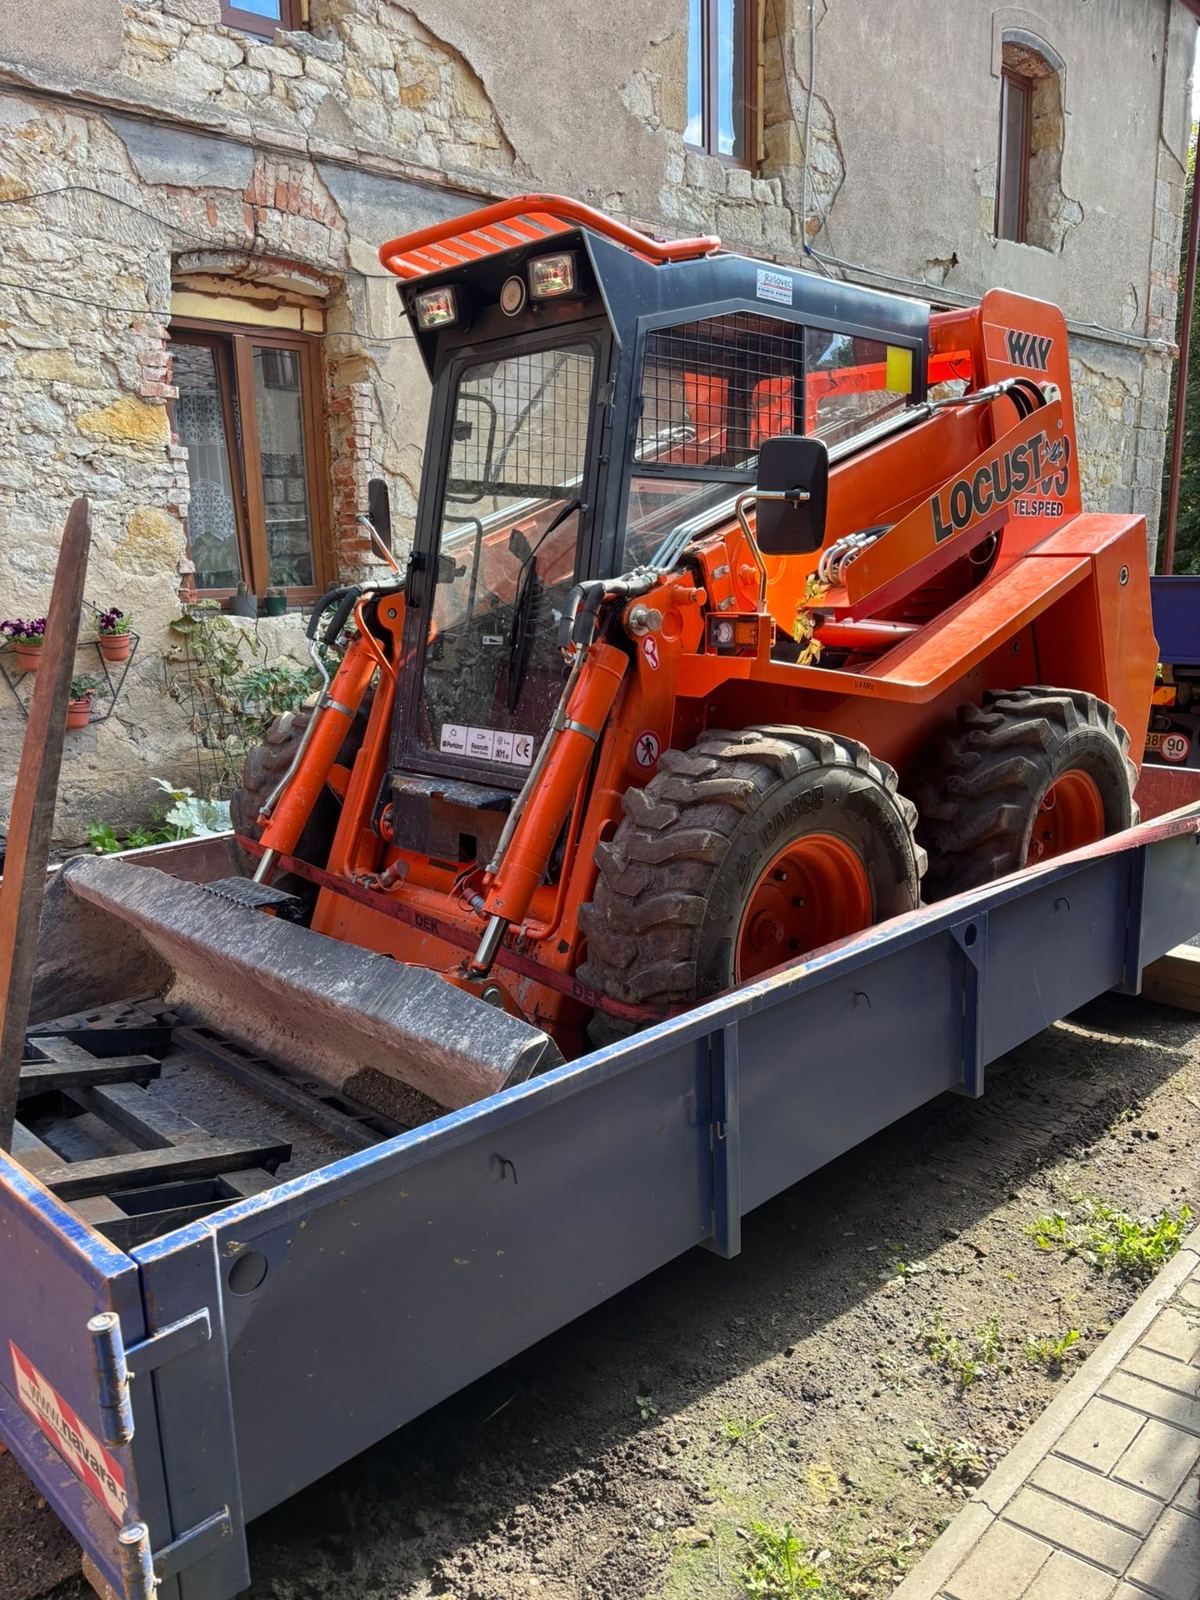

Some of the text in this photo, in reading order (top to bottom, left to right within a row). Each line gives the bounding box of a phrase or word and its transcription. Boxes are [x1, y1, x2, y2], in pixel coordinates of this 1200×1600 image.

[1006, 327, 1054, 372] WAY
[931, 430, 1046, 544] LOCUST
[1014, 499, 1064, 517] TELSPEED
[1166, 738, 1185, 752] 90
